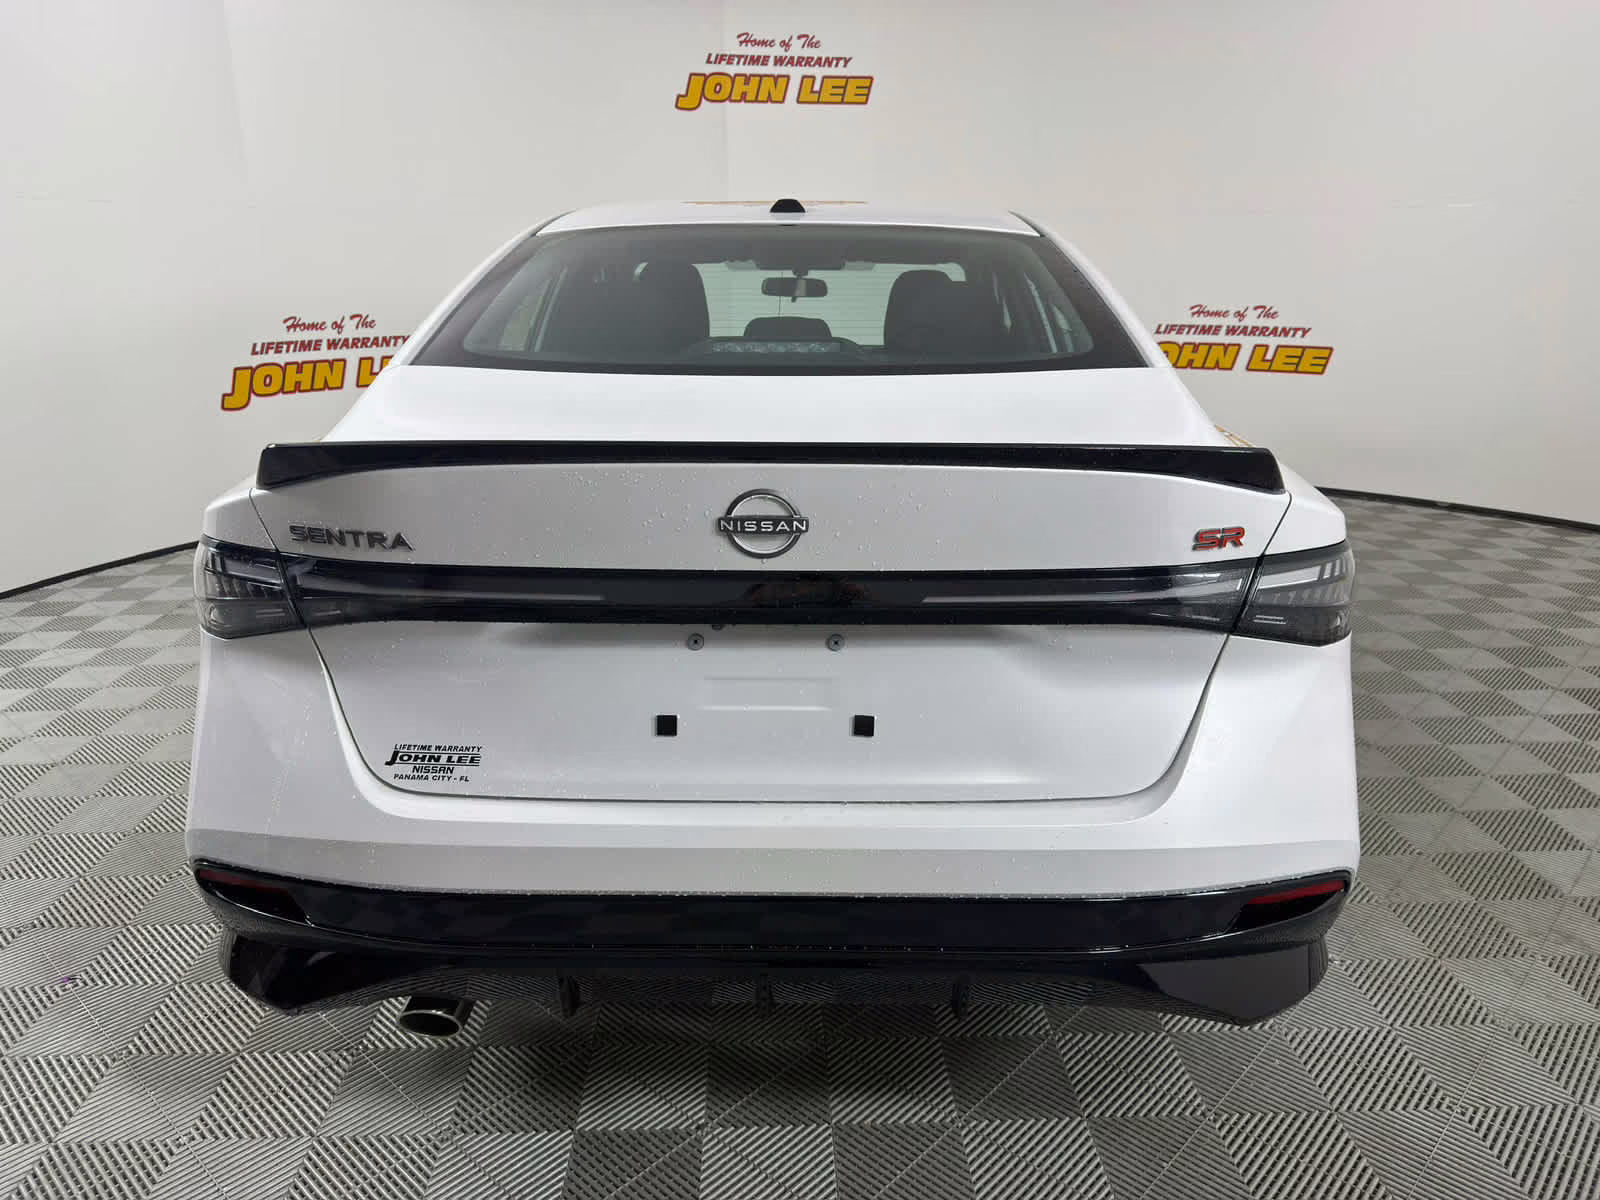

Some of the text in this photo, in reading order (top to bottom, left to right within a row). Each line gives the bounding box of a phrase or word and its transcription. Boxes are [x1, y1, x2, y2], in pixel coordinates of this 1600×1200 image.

[737, 32, 821, 52] Home of The
[706, 53, 852, 68] LIFETIME WARRANTY
[675, 72, 874, 110] JOHN LEE
[1189, 304, 1279, 322] Home of The
[283, 314, 376, 334] Home of The
[1155, 324, 1312, 338] LIFETIME WARRANTY
[251, 339, 322, 355] LIFETIME
[1246, 344, 1333, 375] LEE
[221, 358, 346, 411] JOHN
[720, 519, 806, 532] NISSAN
[289, 525, 414, 550] SENTRA
[1192, 526, 1246, 551] SR
[385, 751, 481, 766] JOHN LEE
[412, 766, 455, 774] NISSAN
